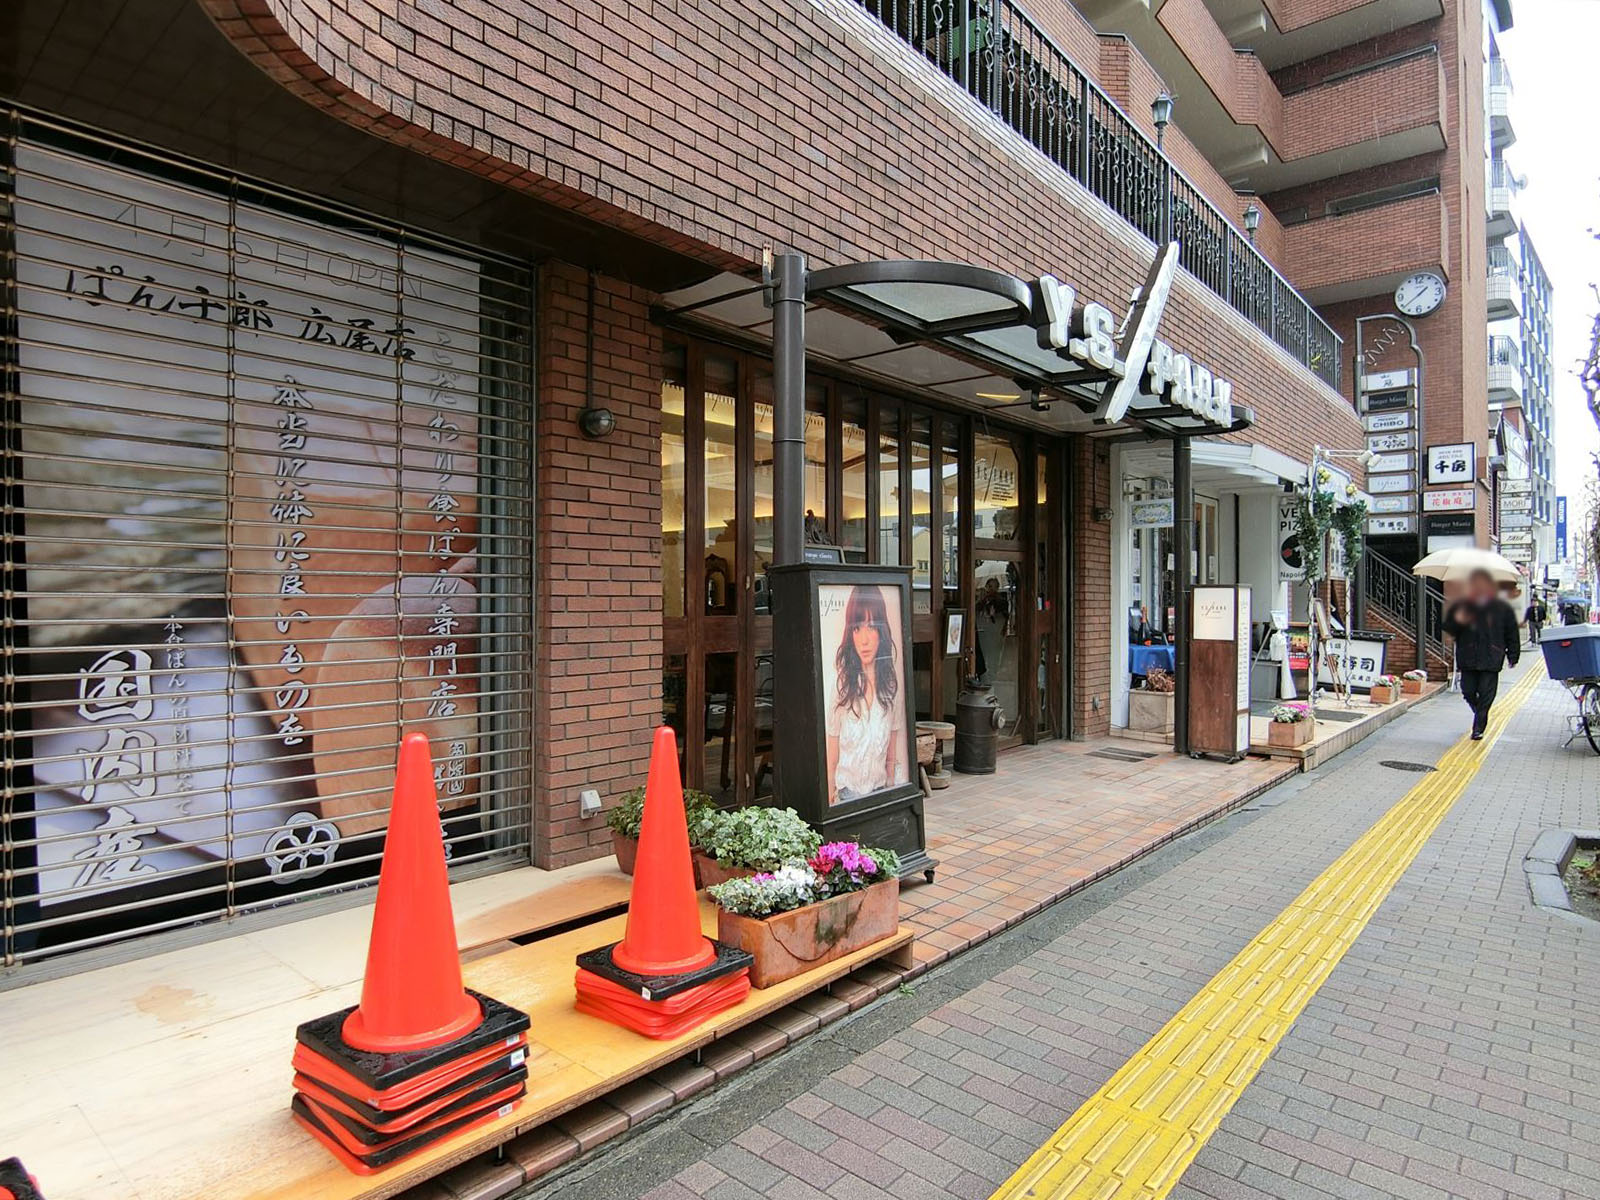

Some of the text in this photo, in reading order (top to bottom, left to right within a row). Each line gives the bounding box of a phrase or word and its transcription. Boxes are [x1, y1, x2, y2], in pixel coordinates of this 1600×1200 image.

[1414, 276, 1424, 285] 12
[1434, 287, 1441, 296] 3
[1415, 305, 1422, 313] 6
[1373, 420, 1404, 428] CHIBO
[76, 648, 158, 888] 国内産
